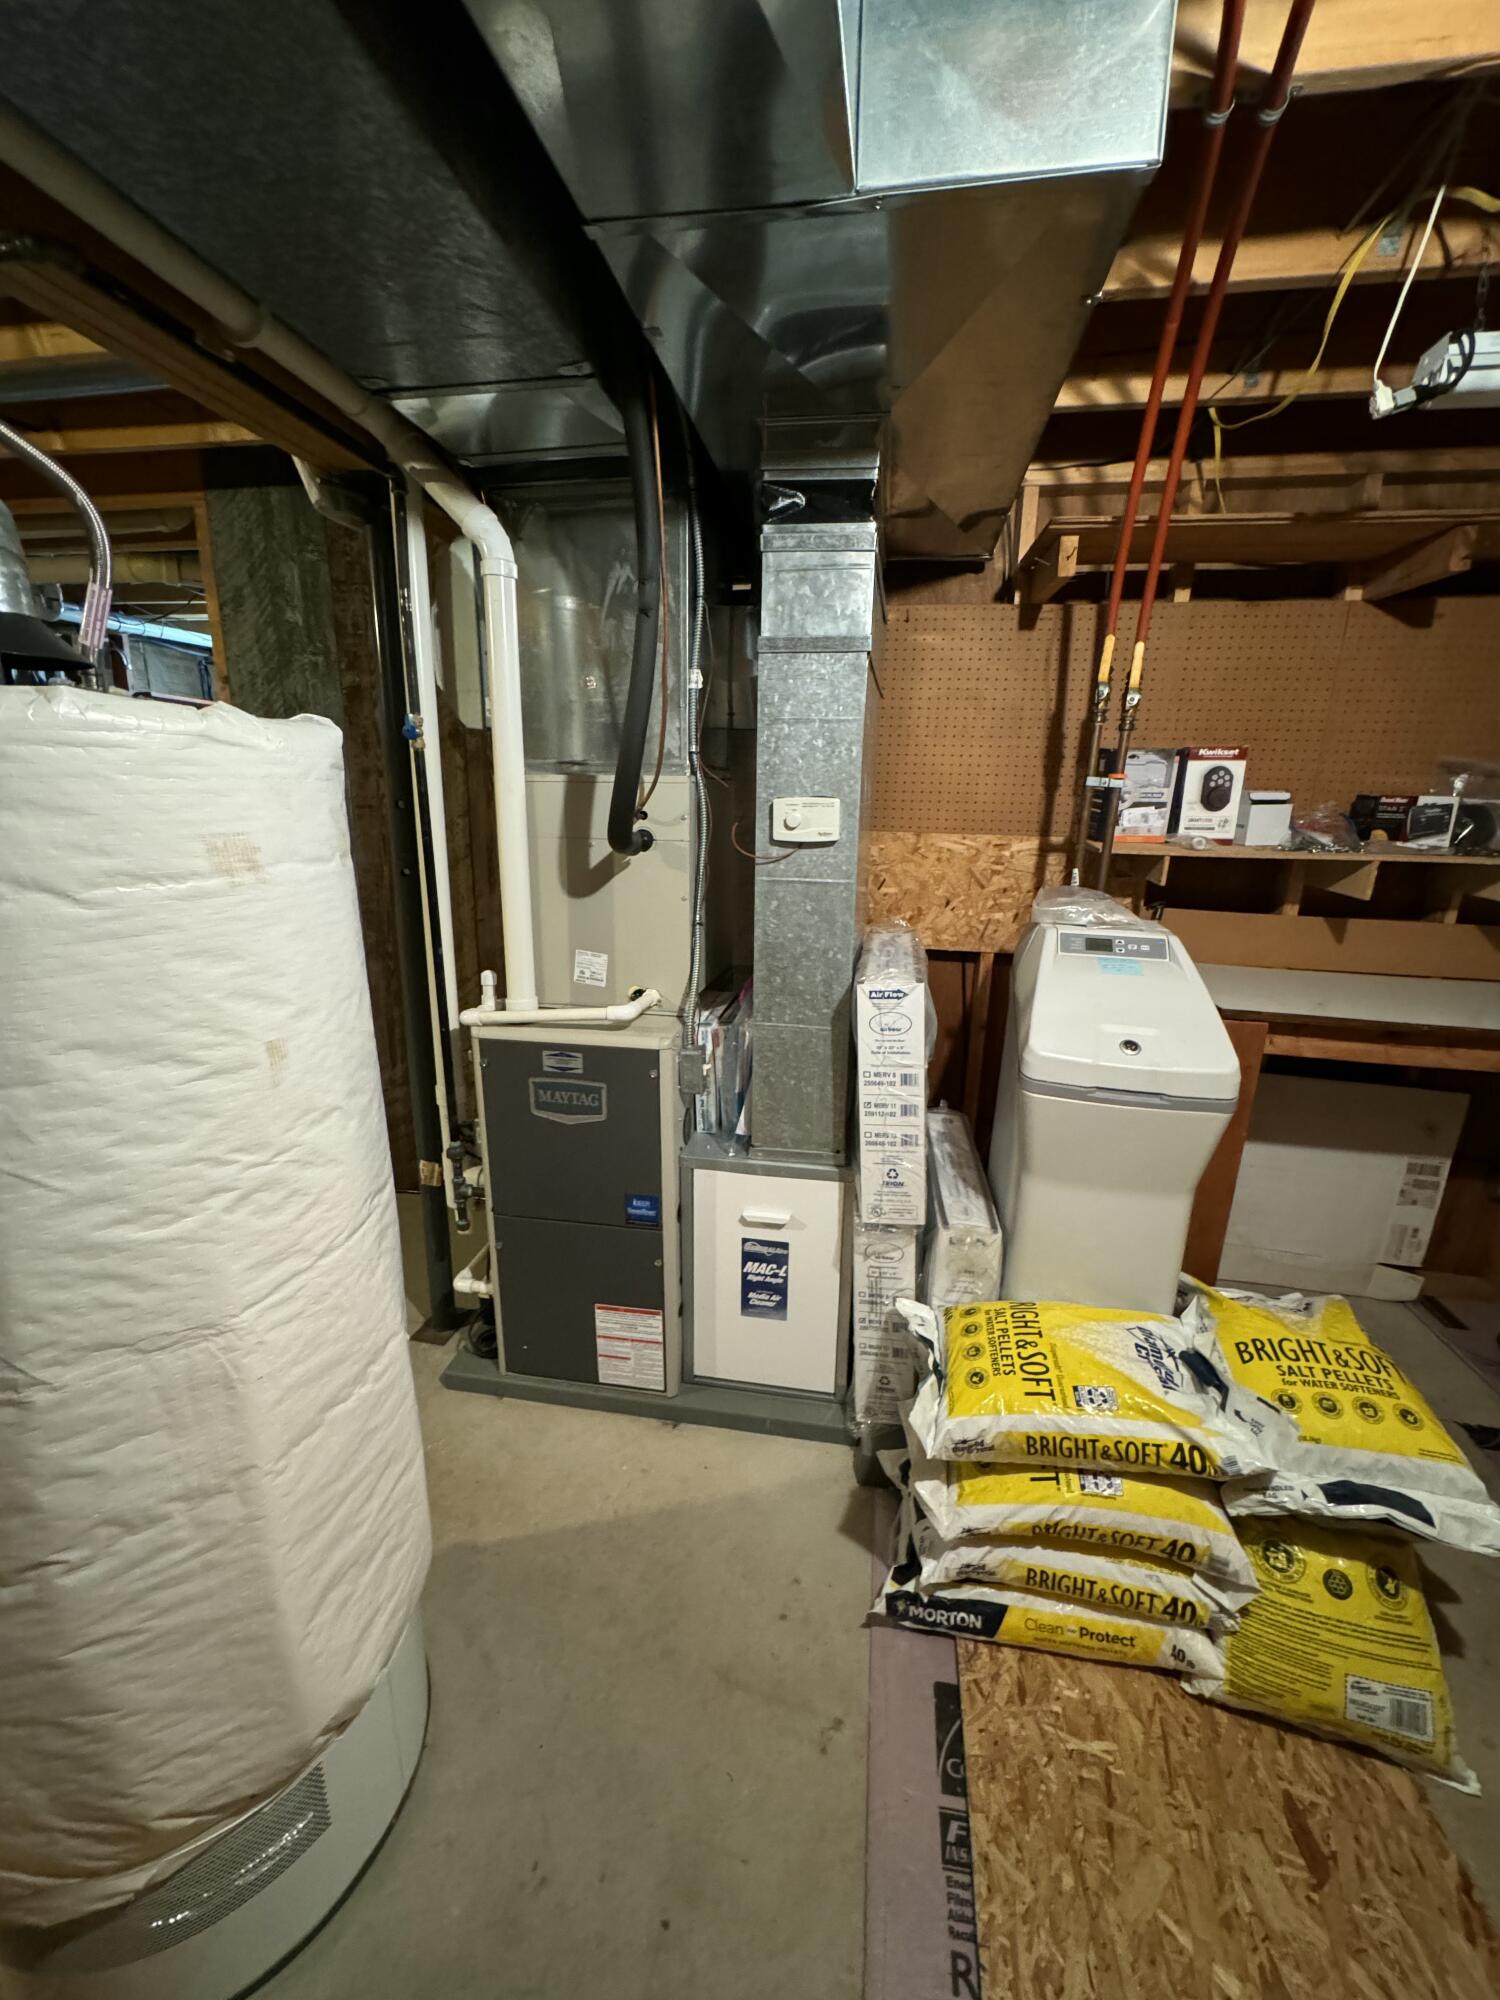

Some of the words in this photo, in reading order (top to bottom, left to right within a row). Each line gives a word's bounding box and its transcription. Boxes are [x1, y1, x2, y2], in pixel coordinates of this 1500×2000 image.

[1198, 748, 1240, 756] Kwikset
[870, 990, 884, 999] Air
[884, 990, 904, 999] Flow
[873, 1071, 892, 1079] MERV
[537, 1088, 600, 1107] MAYTAG
[986, 1335, 1002, 1377] SOFTENERS
[996, 1327, 1017, 1376] PELLETS
[1009, 1301, 1057, 1402] RIGHT&SOFT
[1275, 1364, 1317, 1379] SALT
[1323, 1367, 1395, 1391] PELLETS
[1281, 1378, 1297, 1387] for
[1299, 1378, 1340, 1391] WATER
[1339, 1382, 1401, 1401] SOFTENERS
[1170, 1442, 1207, 1476] 40
[1161, 1538, 1197, 1563] 40
[908, 1603, 982, 1629] MORTON
[1162, 1596, 1198, 1626] 40
[1024, 1617, 1065, 1636] Clean
[1079, 1626, 1136, 1648] Protect
[1170, 1643, 1187, 1664] 40
